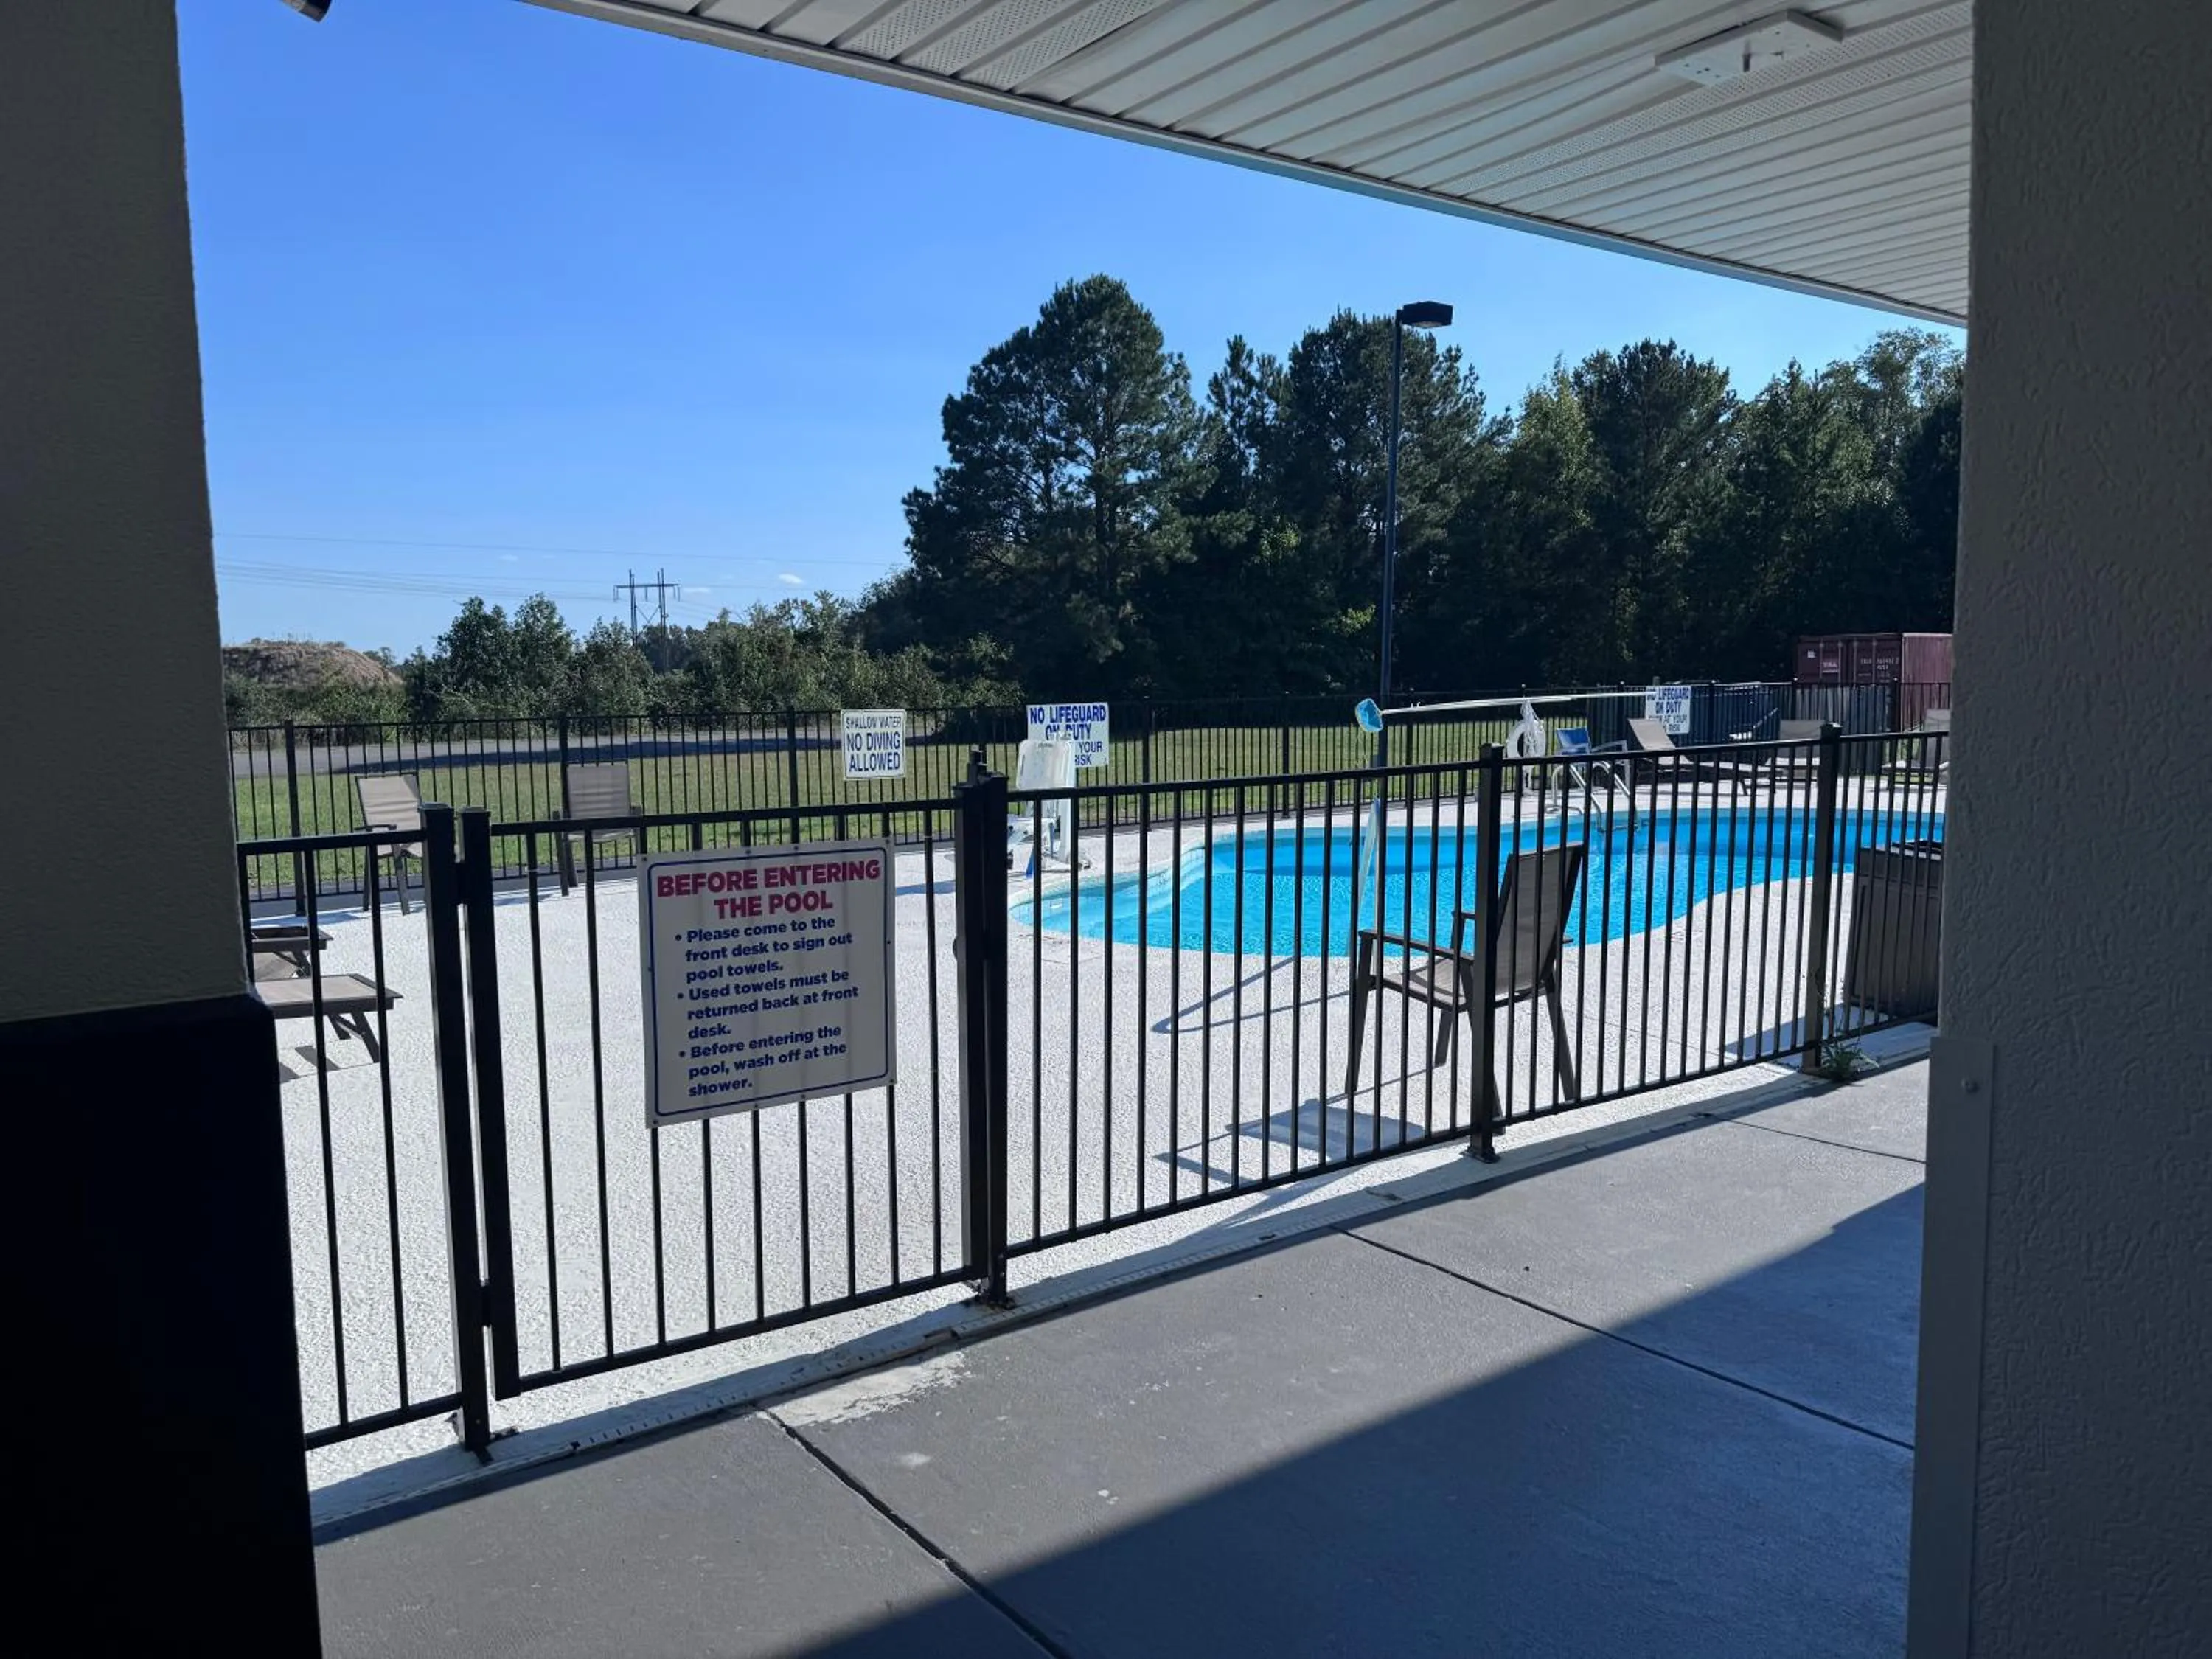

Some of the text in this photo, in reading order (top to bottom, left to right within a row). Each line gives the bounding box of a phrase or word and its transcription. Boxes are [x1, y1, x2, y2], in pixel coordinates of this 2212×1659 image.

[1030, 704, 1106, 723] NO LIFEGUARD
[1666, 701, 1681, 714] DUTY
[846, 716, 901, 729] SHALLOW WATER
[846, 731, 900, 751] NO DIVING
[1079, 741, 1102, 752] YOUR
[849, 752, 900, 771] ALLOWED
[657, 859, 880, 897] BEFORE ENTERING
[714, 890, 834, 919] THE POOL
[686, 917, 835, 942] Please come to the
[686, 932, 853, 961] front desk to sign out
[686, 959, 784, 984] pool towels.
[689, 970, 849, 1001] Used towels must be
[687, 987, 859, 1020] returned back at front
[688, 1023, 731, 1040] desk.
[690, 1026, 841, 1059] Before entering the
[688, 1043, 847, 1080] pool, wash off at the
[688, 1078, 753, 1097] shower.
